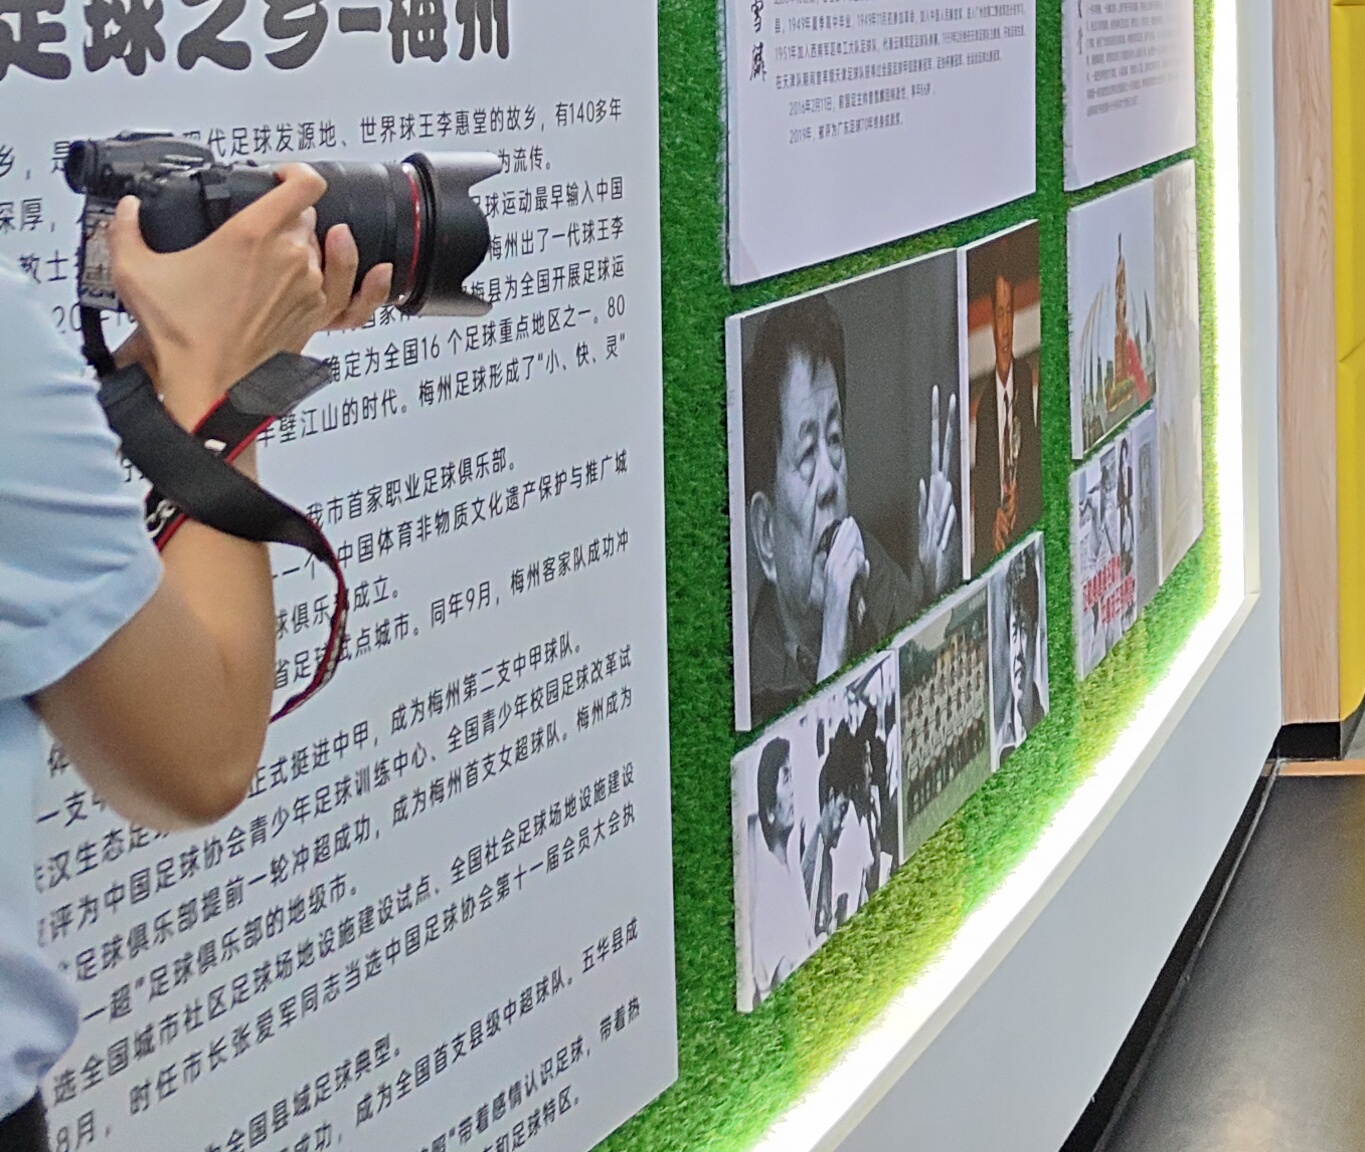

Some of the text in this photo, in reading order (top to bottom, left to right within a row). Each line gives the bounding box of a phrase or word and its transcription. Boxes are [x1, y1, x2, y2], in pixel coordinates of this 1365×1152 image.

[38, 644, 633, 947] 评为中国足球协会青少年足球训练中心、全国青少年校园足球改革试
